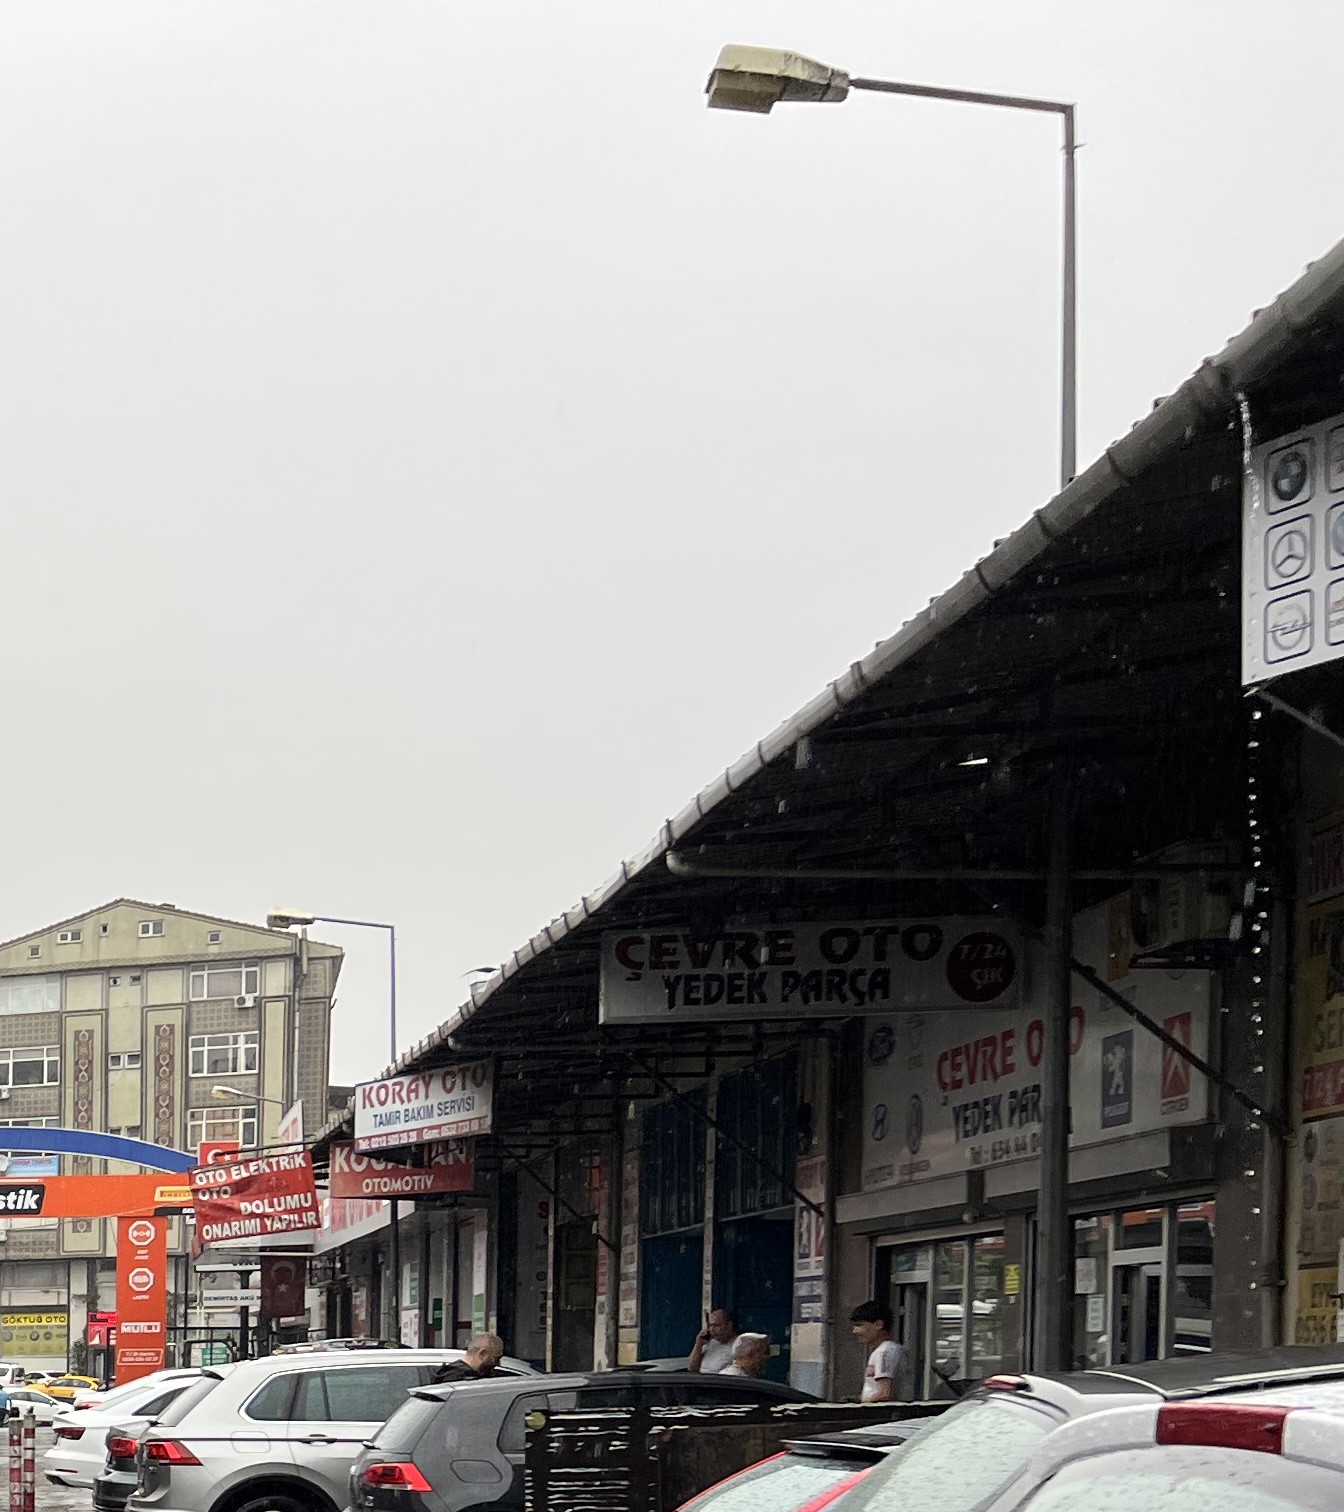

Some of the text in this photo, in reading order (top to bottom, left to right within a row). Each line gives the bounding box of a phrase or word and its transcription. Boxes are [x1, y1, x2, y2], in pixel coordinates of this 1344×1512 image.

[615, 924, 944, 982] ÇEVRE OTO
[662, 967, 890, 1010] YEDEK PARÇA
[937, 1006, 1086, 1106] ÇEVRE OO
[362, 1062, 487, 1110] KORAY OTO
[404, 1104, 434, 1124] BAKIM
[195, 1169, 228, 1186] OTO
[198, 1186, 232, 1200] OTO
[240, 1192, 312, 1215] DOLUMU
[202, 1212, 318, 1240] ONARIMI YAPILIR
[2, 1314, 43, 1324] GÖKTUĞ
[45, 1316, 66, 1324] OTO
